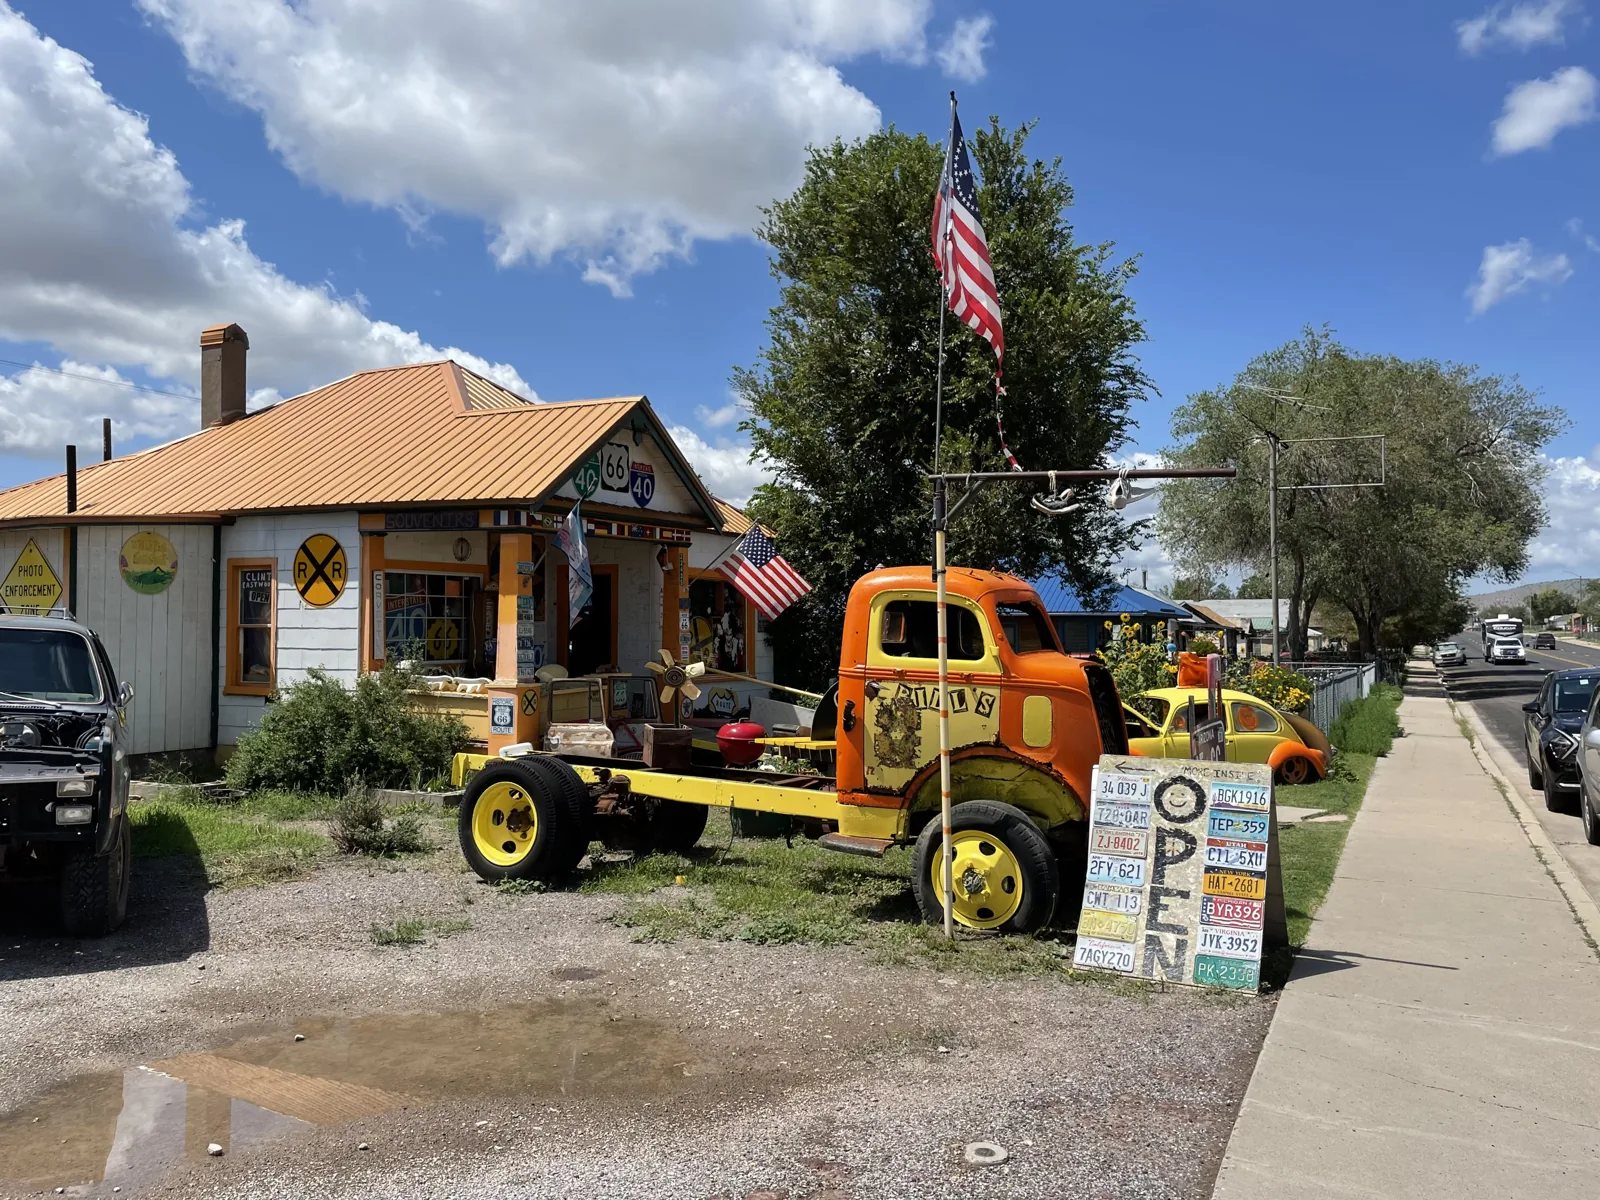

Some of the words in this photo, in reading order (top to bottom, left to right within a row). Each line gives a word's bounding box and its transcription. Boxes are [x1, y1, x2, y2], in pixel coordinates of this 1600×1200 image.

[606, 453, 625, 480] 66
[574, 468, 597, 493] 40
[633, 477, 652, 500] 40
[386, 511, 475, 529] SOUVENIRS
[18, 565, 44, 577] PHOTO
[245, 571, 272, 582] CLINT
[297, 561, 308, 579] R
[332, 561, 342, 579] R
[5, 584, 56, 597] ENFORCEMENT
[251, 591, 270, 603] OPEN
[20, 604, 40, 616] ZONE
[387, 595, 424, 610] INTERSTATE
[386, 607, 427, 650] 40
[681, 621, 688, 630] 66
[433, 626, 453, 651] 66
[715, 698, 732, 710] ROUTE
[496, 716, 508, 724] 66
[1213, 769, 1255, 781] INSIE
[1101, 780, 1114, 794] 34
[1117, 782, 1137, 796] 039
[1140, 783, 1147, 797] J
[1217, 788, 1266, 806] BGK1916
[1211, 817, 1233, 831] TEP
[1241, 820, 1266, 834] 359
[1097, 835, 1140, 851] ZJ-8402
[1225, 841, 1248, 849] UTAH
[1239, 850, 1263, 866] 5XU
[1090, 860, 1114, 876] 2FY
[1119, 863, 1141, 880] 621
[1141, 775, 1207, 983] OPEN
[1208, 875, 1228, 890] HAT
[1234, 877, 1259, 894] 2681
[1117, 894, 1138, 909] 113
[1206, 901, 1261, 920] BYR396
[1215, 928, 1245, 936] VIRGINIA
[1201, 933, 1258, 953] JVK-3952
[1080, 947, 1131, 967] 7AGY270
